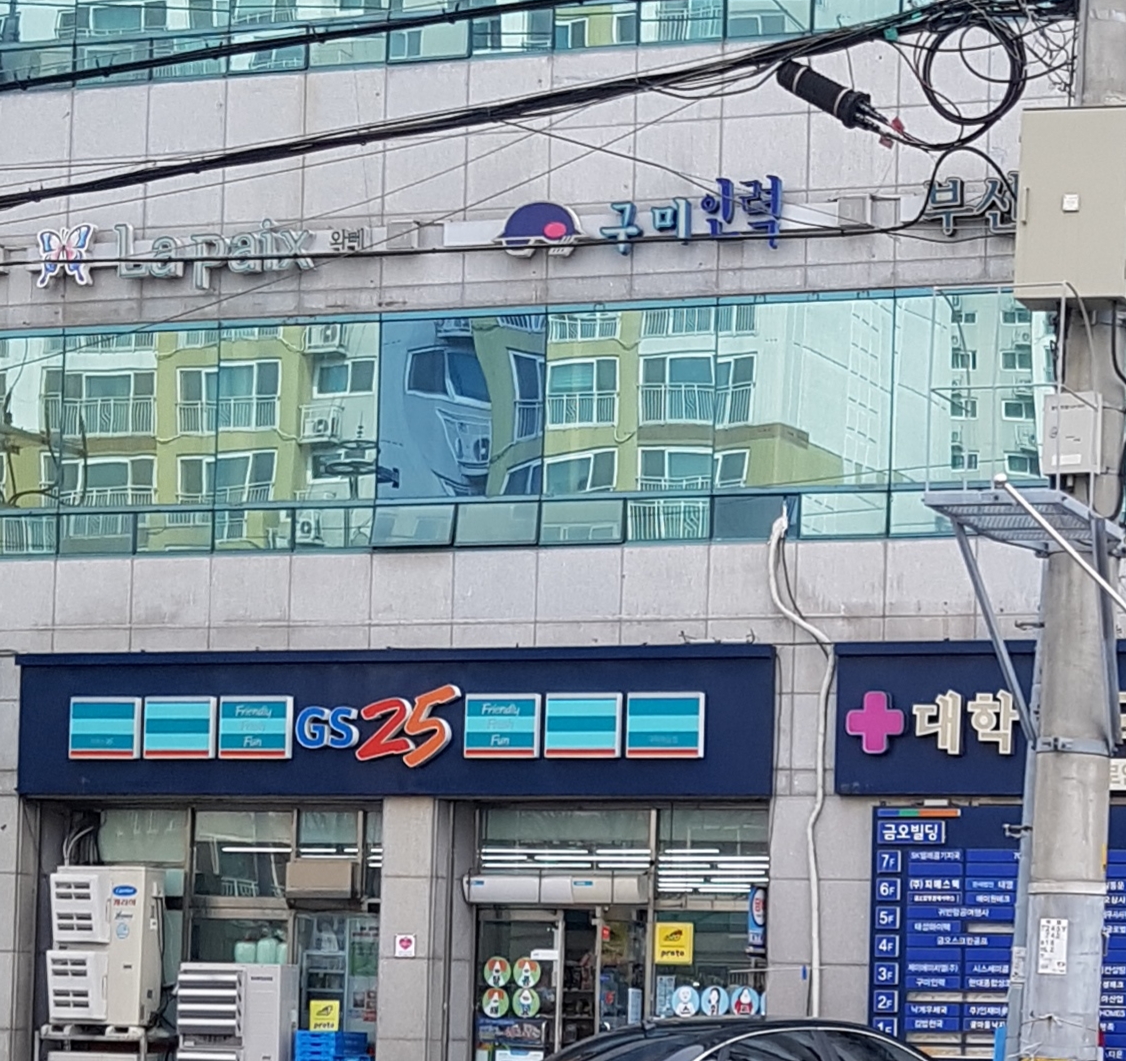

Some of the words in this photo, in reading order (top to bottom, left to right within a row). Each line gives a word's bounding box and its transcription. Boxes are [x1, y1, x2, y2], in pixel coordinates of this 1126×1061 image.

[600, 174, 783, 255] 구미인력
[235, 704, 272, 719] Friendly
[481, 703, 521, 717] Friendly
[296, 684, 463, 769] GS25
[243, 736, 262, 747] Fun
[490, 734, 510, 746] Fun
[882, 823, 938, 841] 금오빌딩
[881, 854, 895, 869] 7F
[879, 882, 895, 896] 6F
[879, 911, 894, 925] 5F
[878, 939, 893, 952] 4F
[660, 949, 685, 958] proto
[877, 967, 893, 981] 3F
[877, 995, 893, 1009] 2F
[313, 1021, 335, 1030] proto
